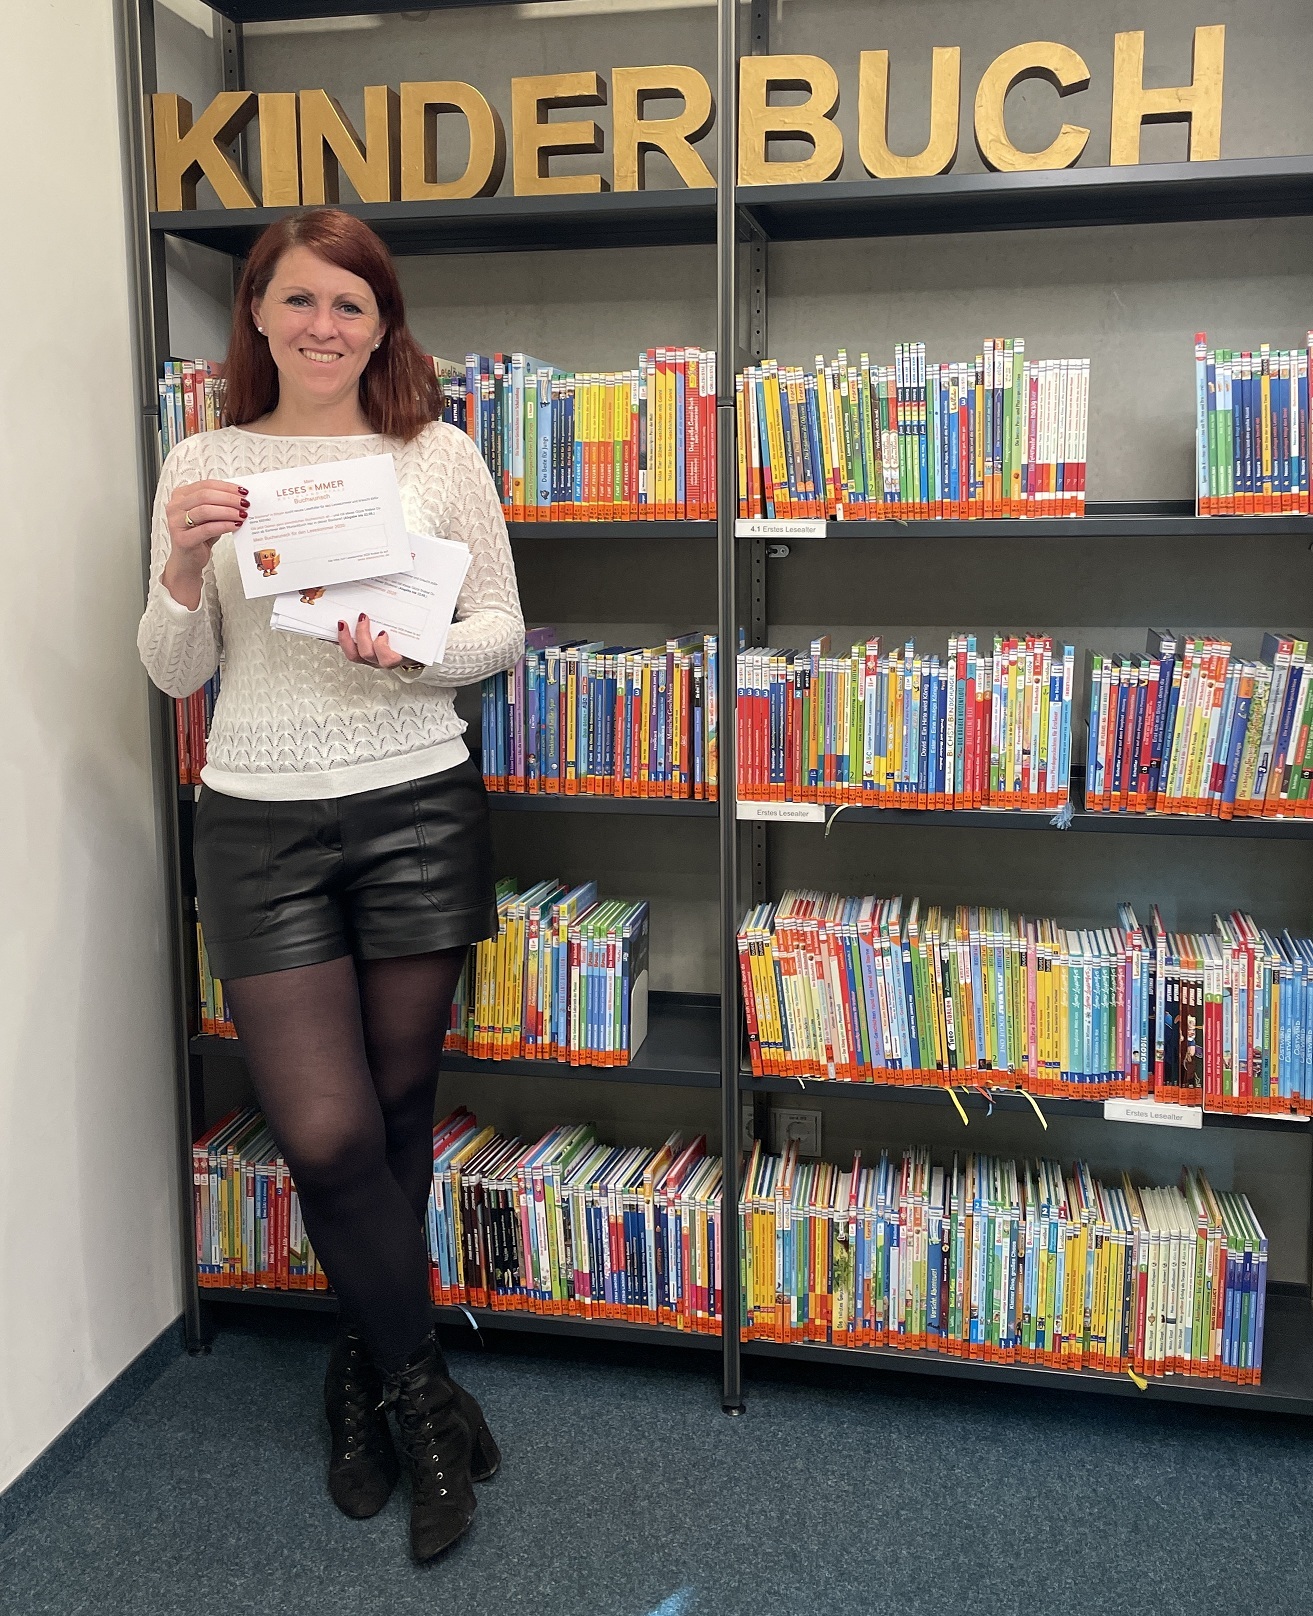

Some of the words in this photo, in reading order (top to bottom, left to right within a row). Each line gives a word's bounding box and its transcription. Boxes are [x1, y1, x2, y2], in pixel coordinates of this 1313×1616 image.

[153, 25, 1226, 212] KINDERBUCH
[1126, 1109, 1148, 1117] Erstes
[1150, 1112, 1183, 1121] Lesealter
